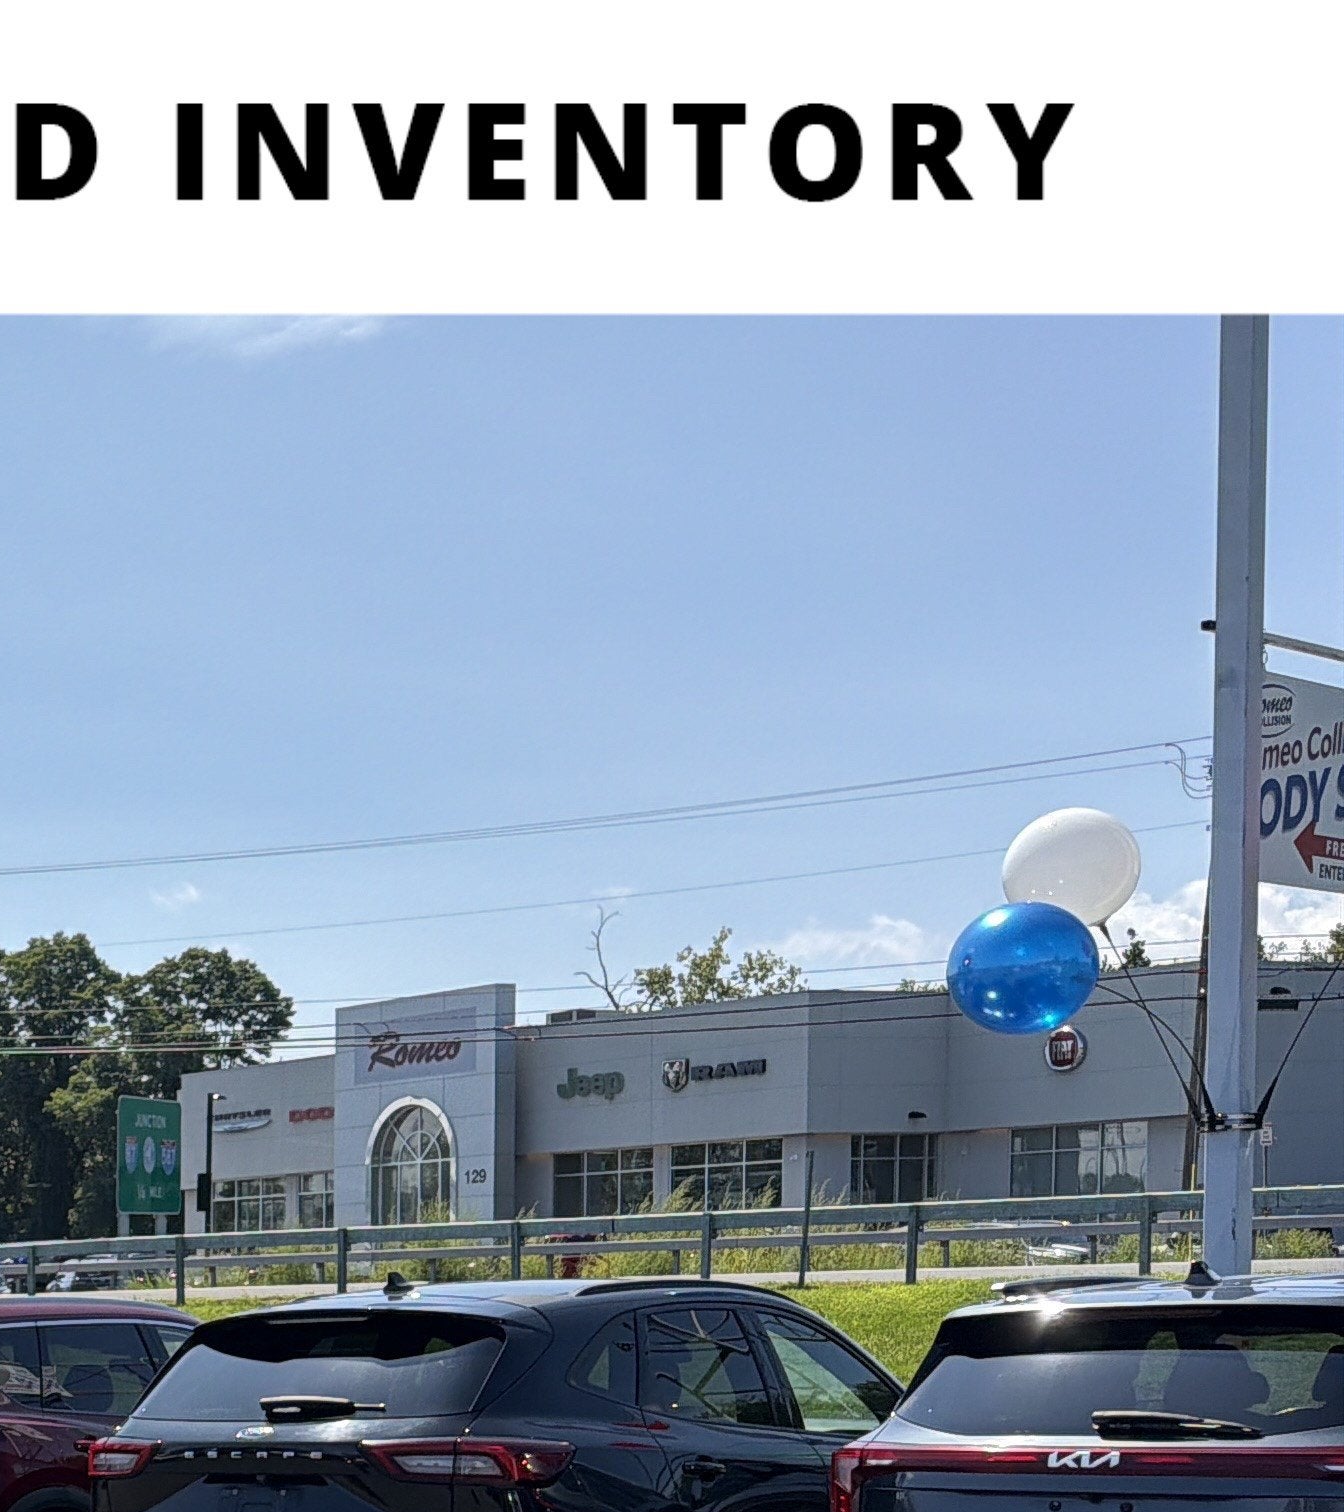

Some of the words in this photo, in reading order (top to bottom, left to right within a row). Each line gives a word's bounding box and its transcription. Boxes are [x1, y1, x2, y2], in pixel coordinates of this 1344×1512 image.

[368, 1031, 462, 1073] Romeo
[691, 1059, 767, 1081] RAM
[556, 1067, 626, 1101] Jeep
[465, 1168, 487, 1184] 129
[184, 1450, 323, 1459] ESCAPE
[1047, 1450, 1120, 1468] KIA
